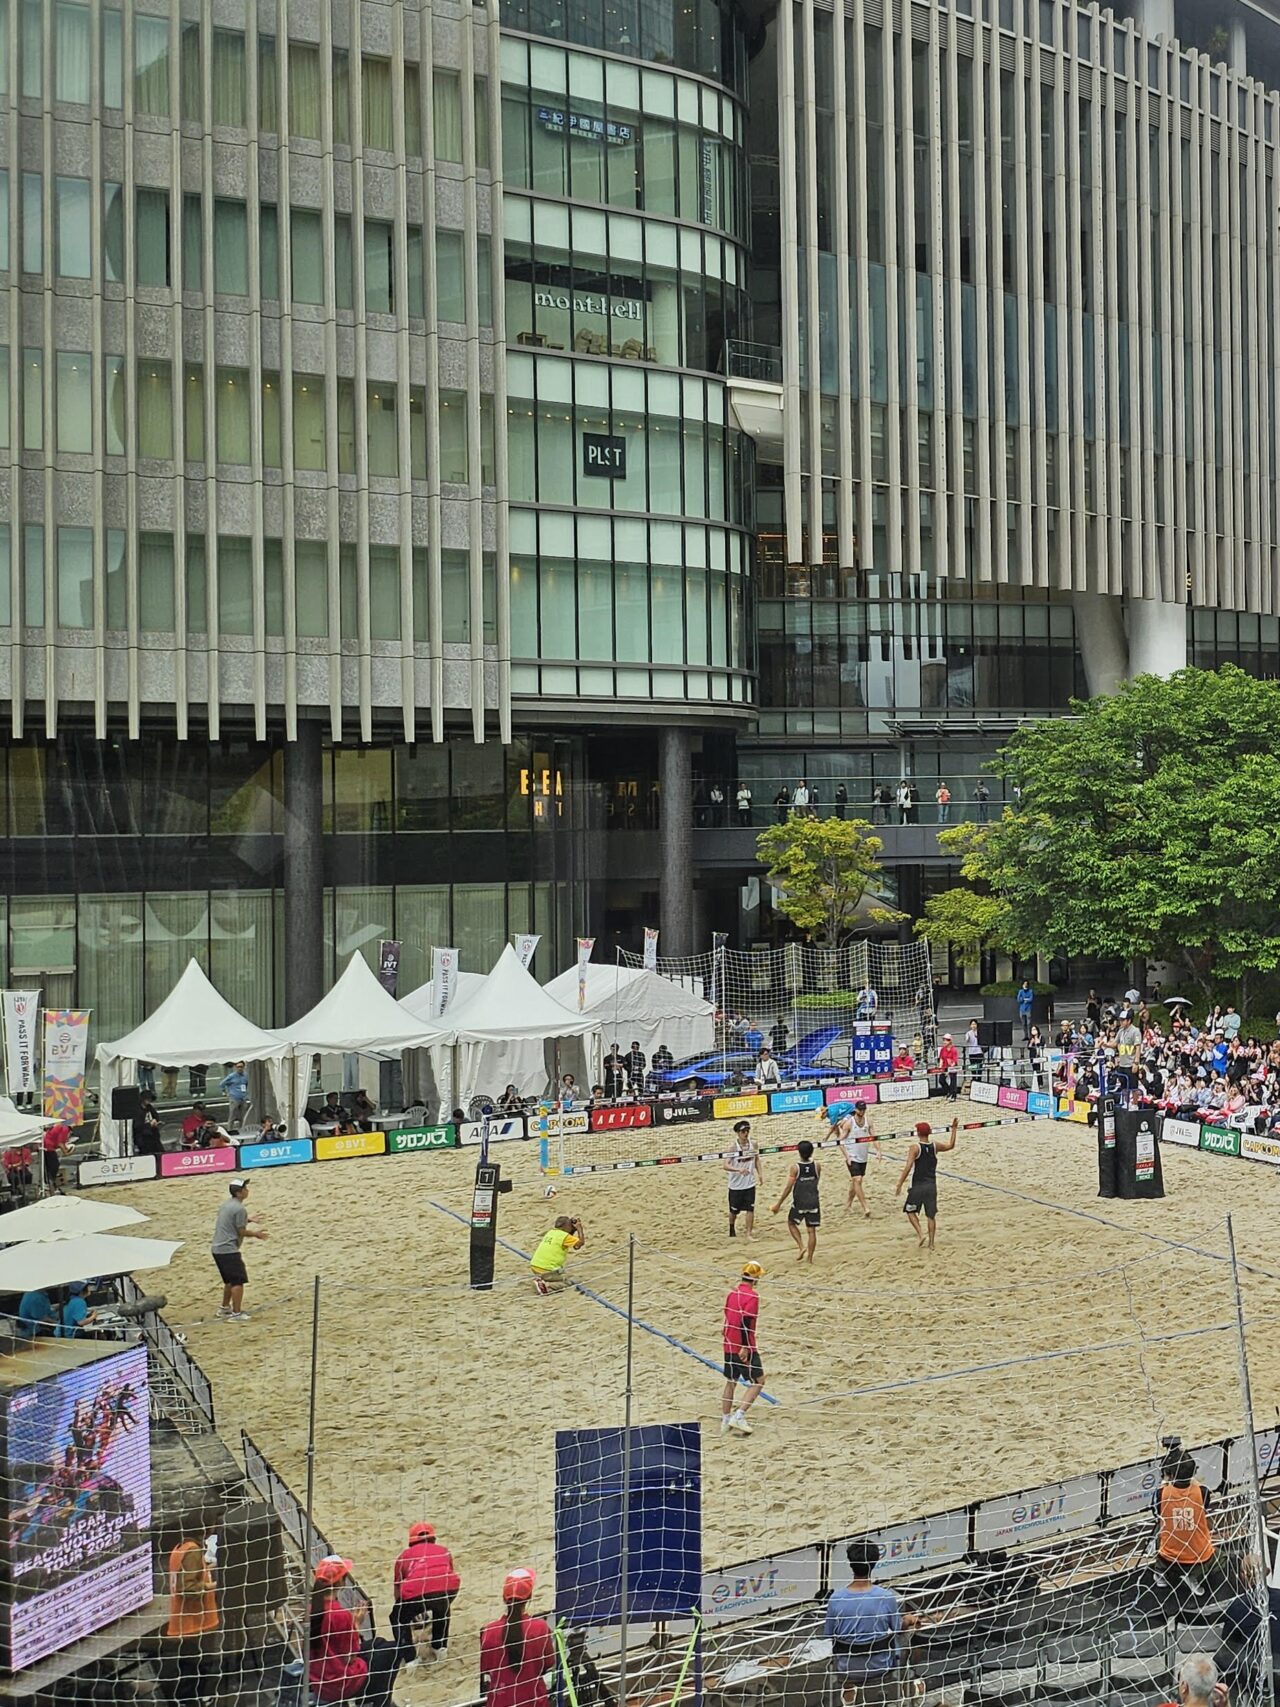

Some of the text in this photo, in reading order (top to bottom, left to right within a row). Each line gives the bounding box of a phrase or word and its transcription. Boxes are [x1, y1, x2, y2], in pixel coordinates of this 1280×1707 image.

[588, 445, 622, 467] PLST
[52, 1044, 78, 1056] BVT
[795, 1094, 809, 1103] BVT
[847, 1089, 864, 1098] BVT
[597, 1109, 646, 1125] AKTIO
[673, 1108, 687, 1116] JVA
[530, 1116, 585, 1132] CPCOM
[345, 1137, 366, 1149] BVT
[396, 1127, 449, 1149] サロンパス
[1204, 1131, 1236, 1151] サロンパス
[270, 1146, 291, 1157] BVT
[1242, 1139, 1280, 1157] CAPCOM
[192, 1153, 216, 1165] BVT
[112, 1162, 135, 1173] BVT
[484, 1173, 489, 1182] 1
[1030, 1494, 1066, 1520] BVT
[60, 1509, 106, 1542] JAPAN
[995, 1528, 1014, 1537] JAPAN
[890, 1530, 932, 1558] BVT
[44, 1530, 122, 1575] TOUR 2025
[735, 1568, 779, 1598] BVT
